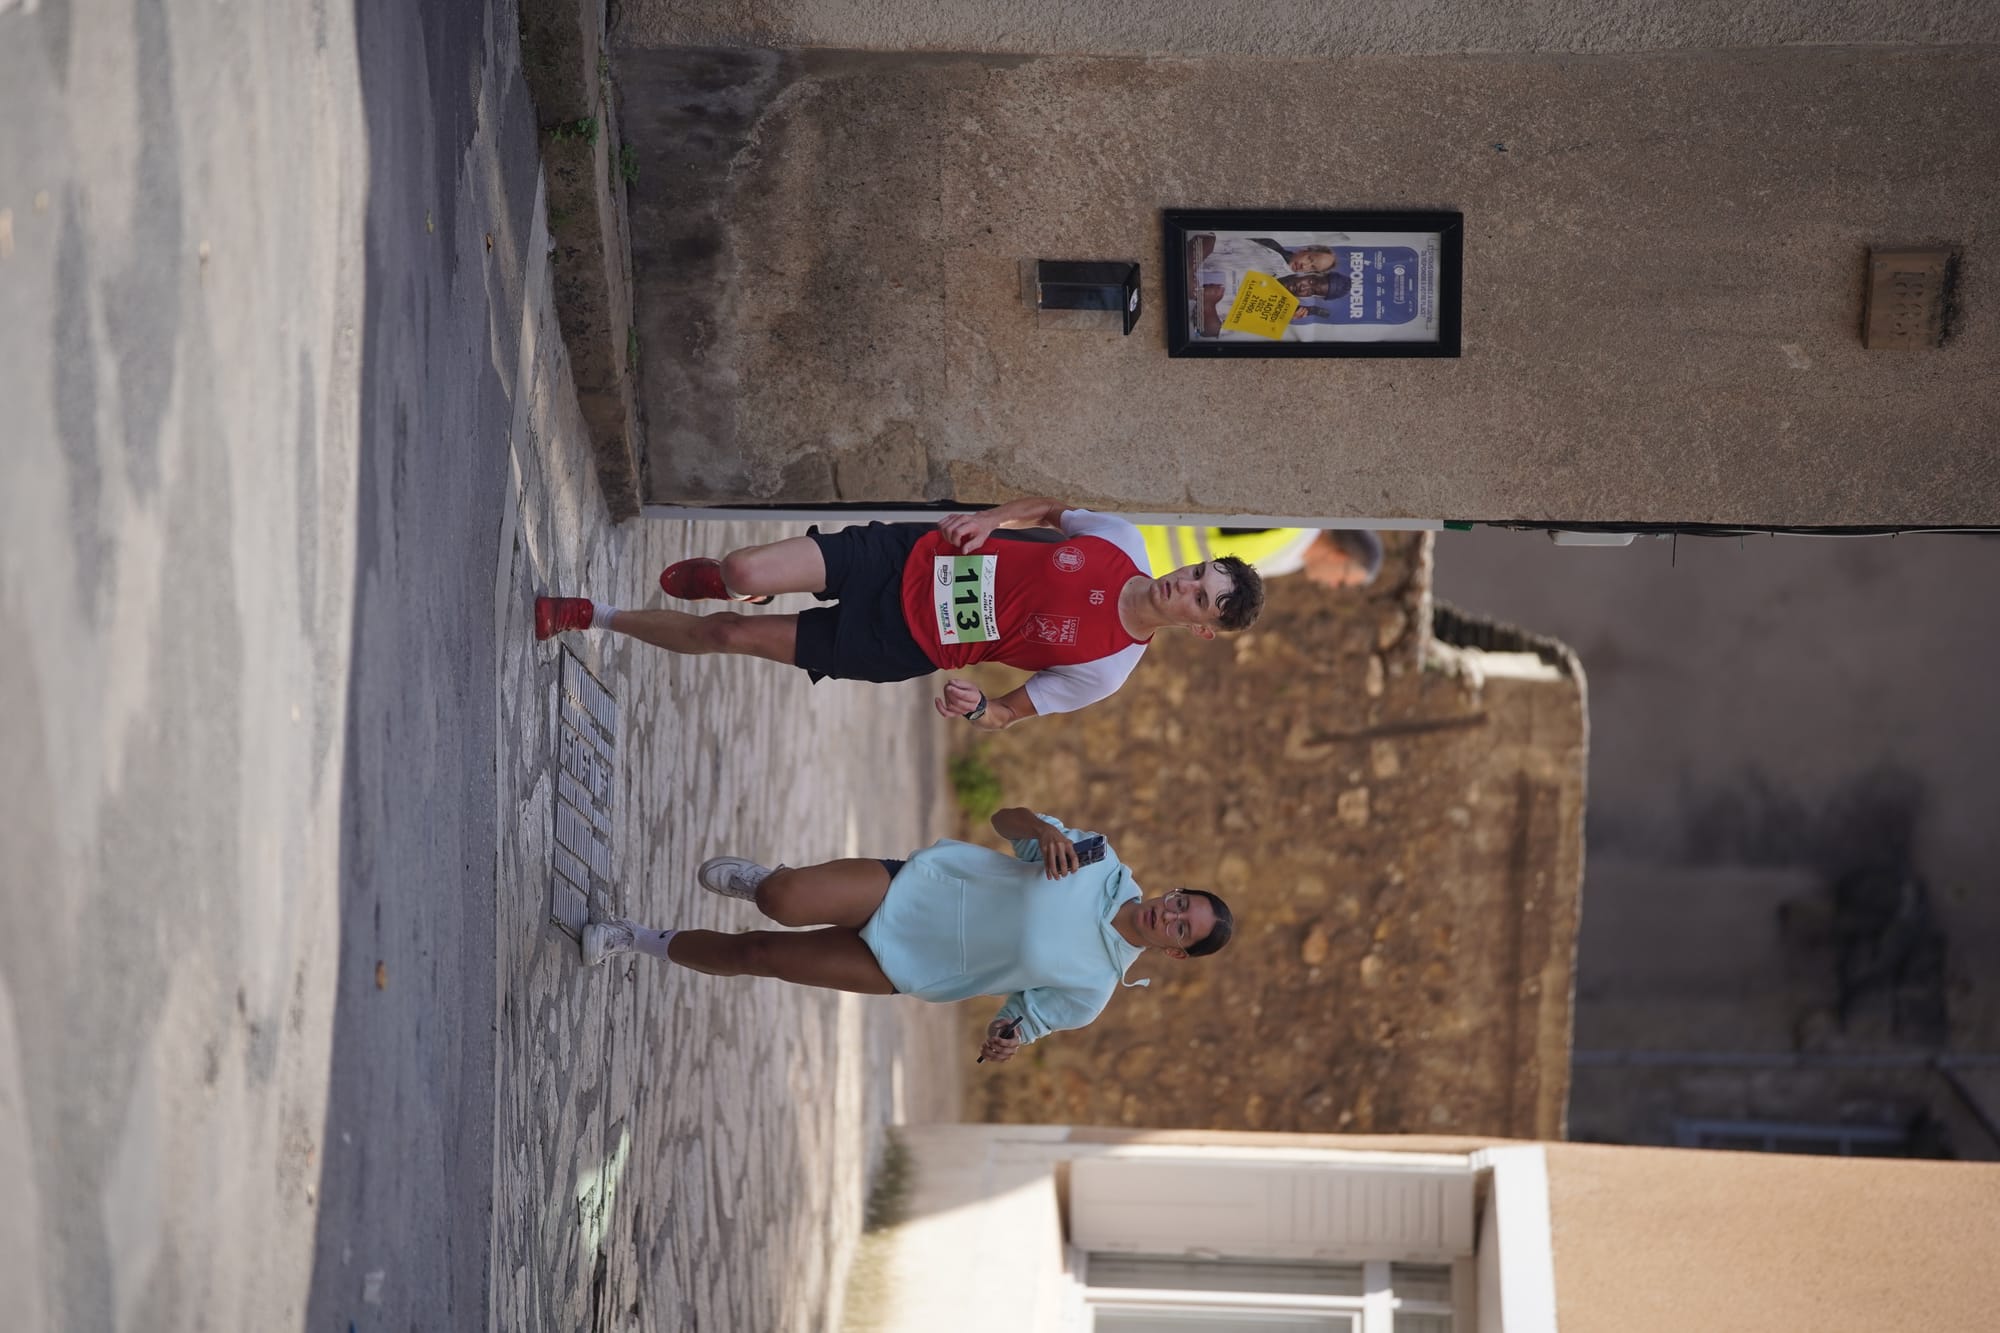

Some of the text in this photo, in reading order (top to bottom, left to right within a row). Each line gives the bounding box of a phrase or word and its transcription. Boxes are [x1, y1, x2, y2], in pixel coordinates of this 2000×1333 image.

[1350, 252, 1364, 318] RÉPONDEUR
[1254, 299, 1266, 312] 2025
[1270, 296, 1287, 322] MERCREDI
[955, 568, 980, 630] 113
[1060, 619, 1070, 642] TRAIL
